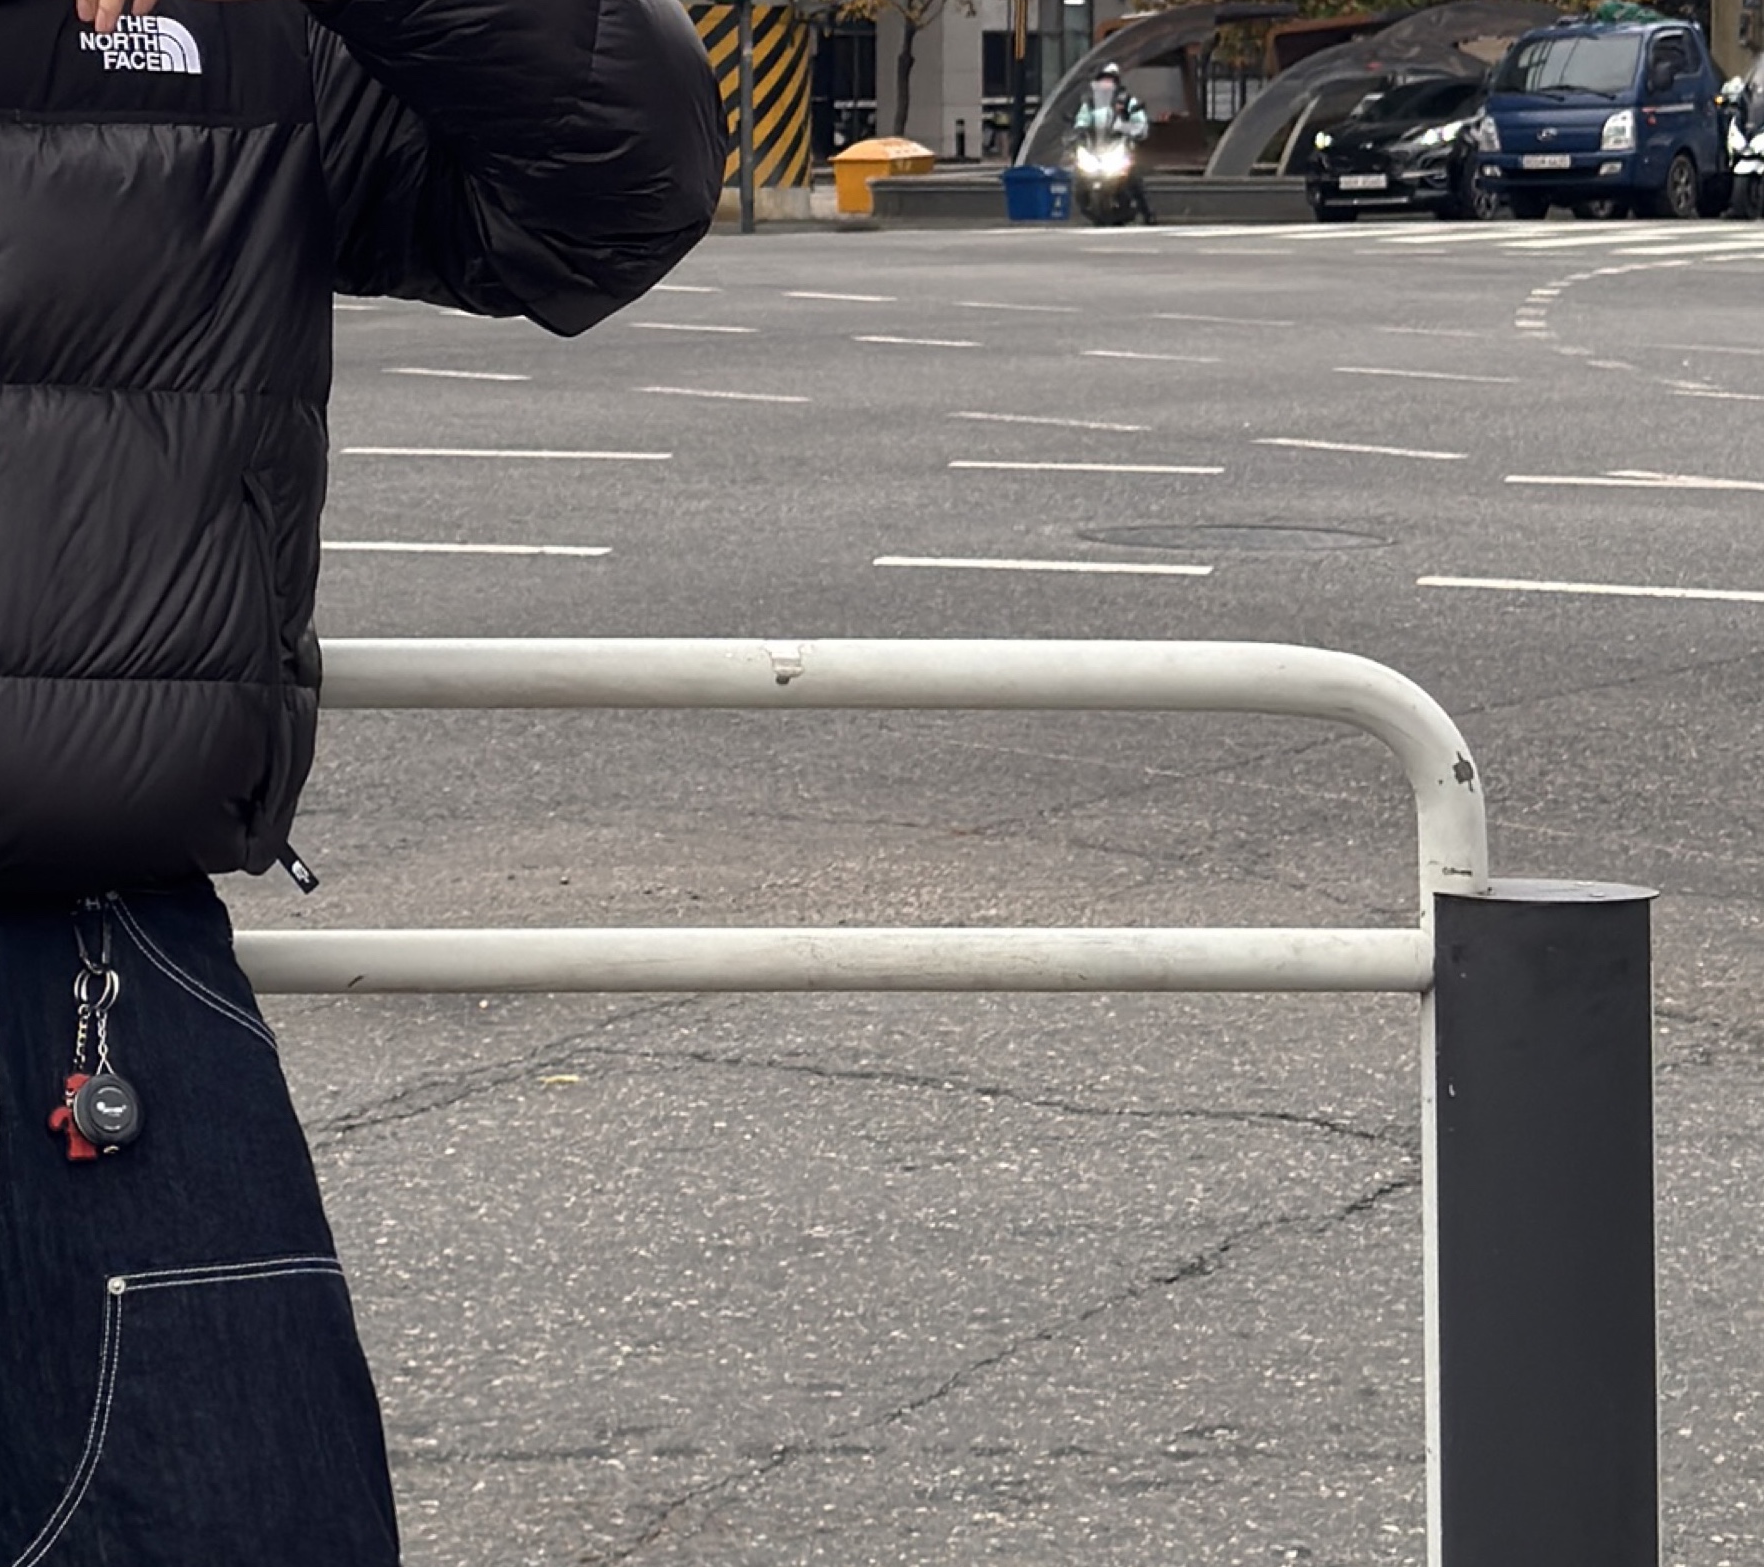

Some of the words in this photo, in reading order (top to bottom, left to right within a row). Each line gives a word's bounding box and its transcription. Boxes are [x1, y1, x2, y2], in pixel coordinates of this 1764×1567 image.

[117, 16, 157, 33] THE
[79, 31, 158, 51] NORTH
[103, 51, 161, 71] FACE
